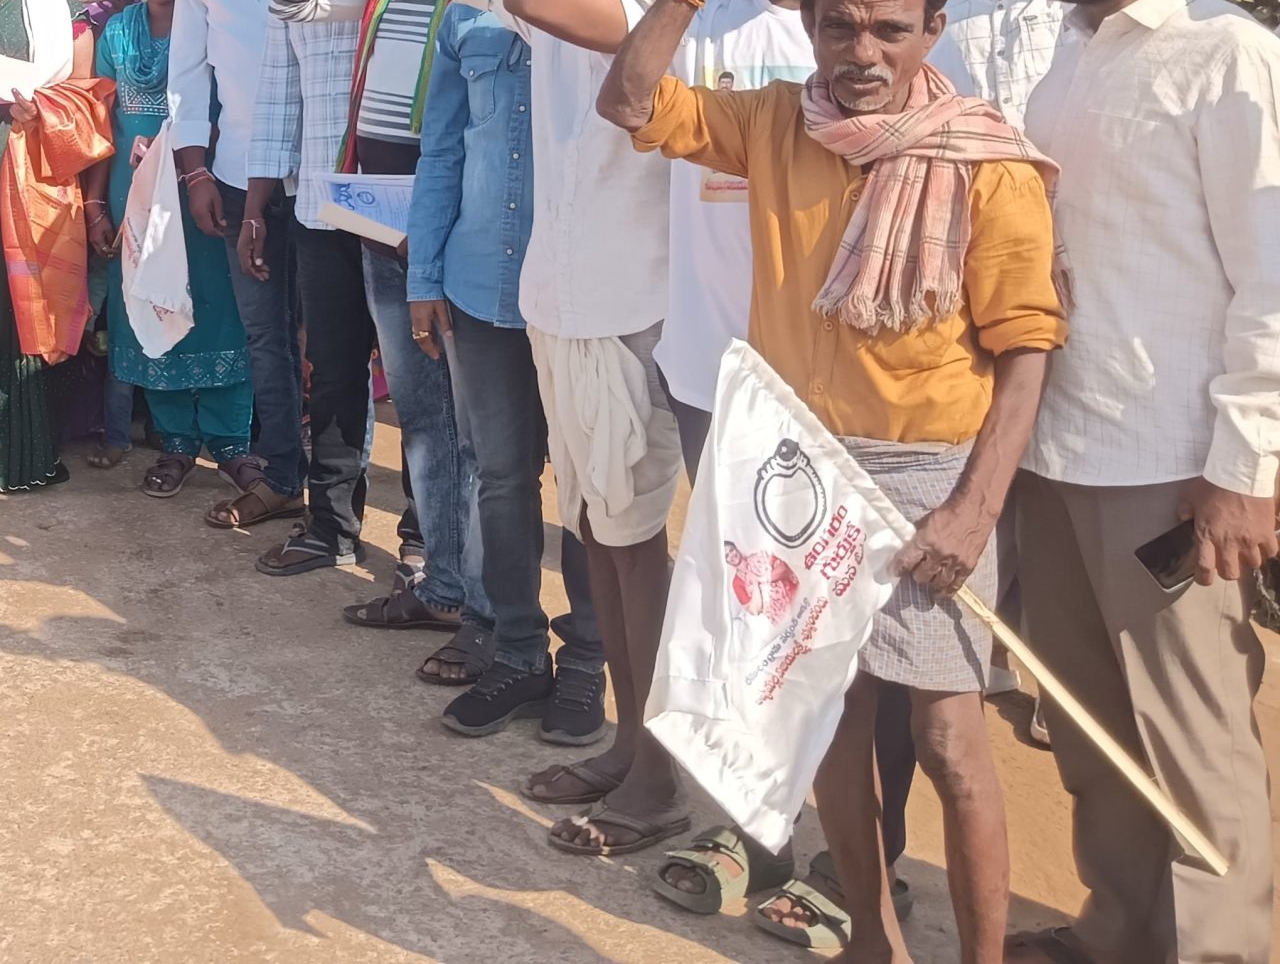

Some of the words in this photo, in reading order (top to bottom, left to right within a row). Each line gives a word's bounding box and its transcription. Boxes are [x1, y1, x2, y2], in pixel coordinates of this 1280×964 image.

[804, 505, 848, 570] ఉంగరం
[820, 520, 861, 580] గుర్తుకే
[832, 564, 857, 597] మన
